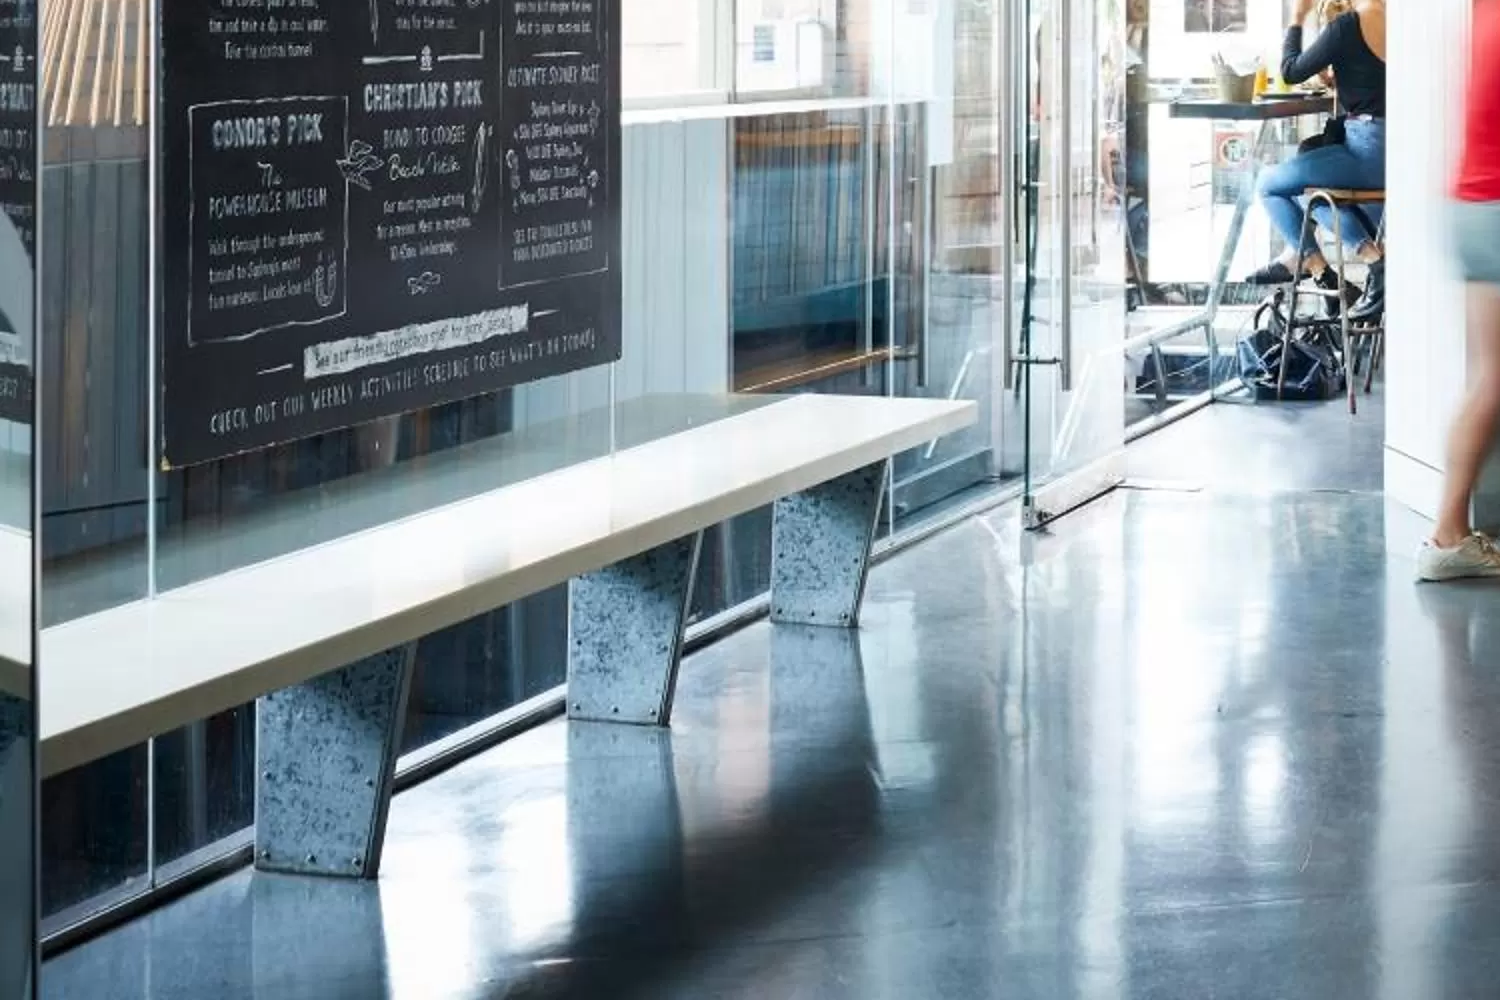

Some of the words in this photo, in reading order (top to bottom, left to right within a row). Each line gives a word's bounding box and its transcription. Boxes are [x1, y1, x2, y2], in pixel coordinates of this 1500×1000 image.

[363, 80, 448, 114] CHRISTIAN'S
[453, 79, 483, 108] PICK
[212, 114, 280, 151] CONOR'S
[287, 112, 323, 145] PICK
